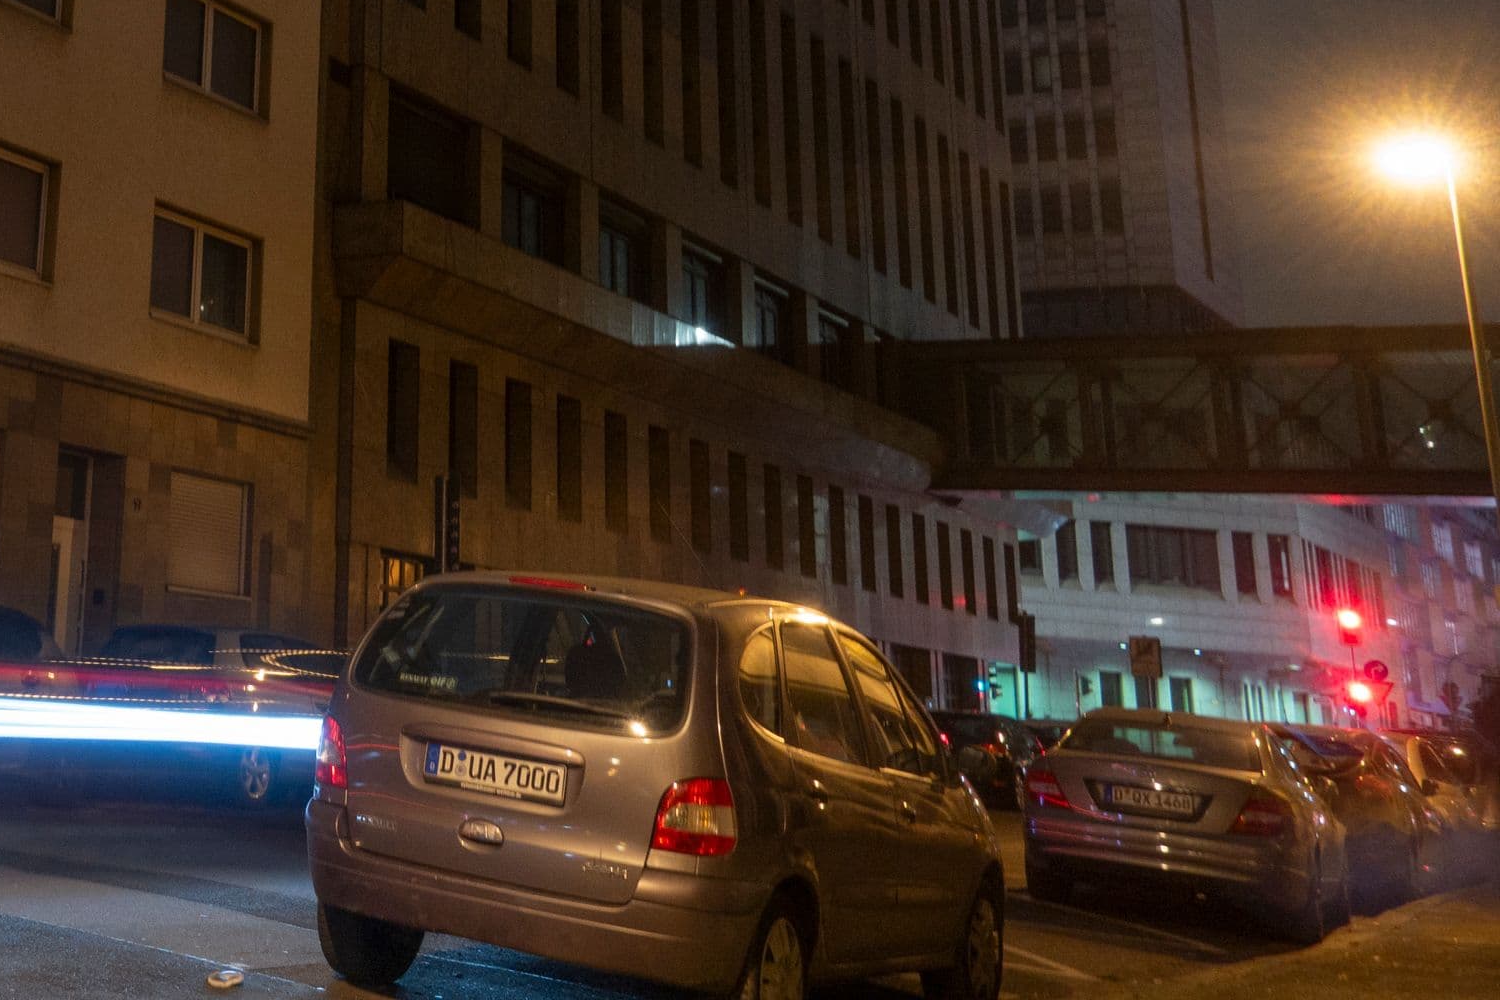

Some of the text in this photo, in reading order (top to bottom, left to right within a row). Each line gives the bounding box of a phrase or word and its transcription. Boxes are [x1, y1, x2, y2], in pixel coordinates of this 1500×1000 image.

[440, 750, 455, 774] D
[469, 754, 496, 783] UA
[504, 761, 560, 794] 7000
